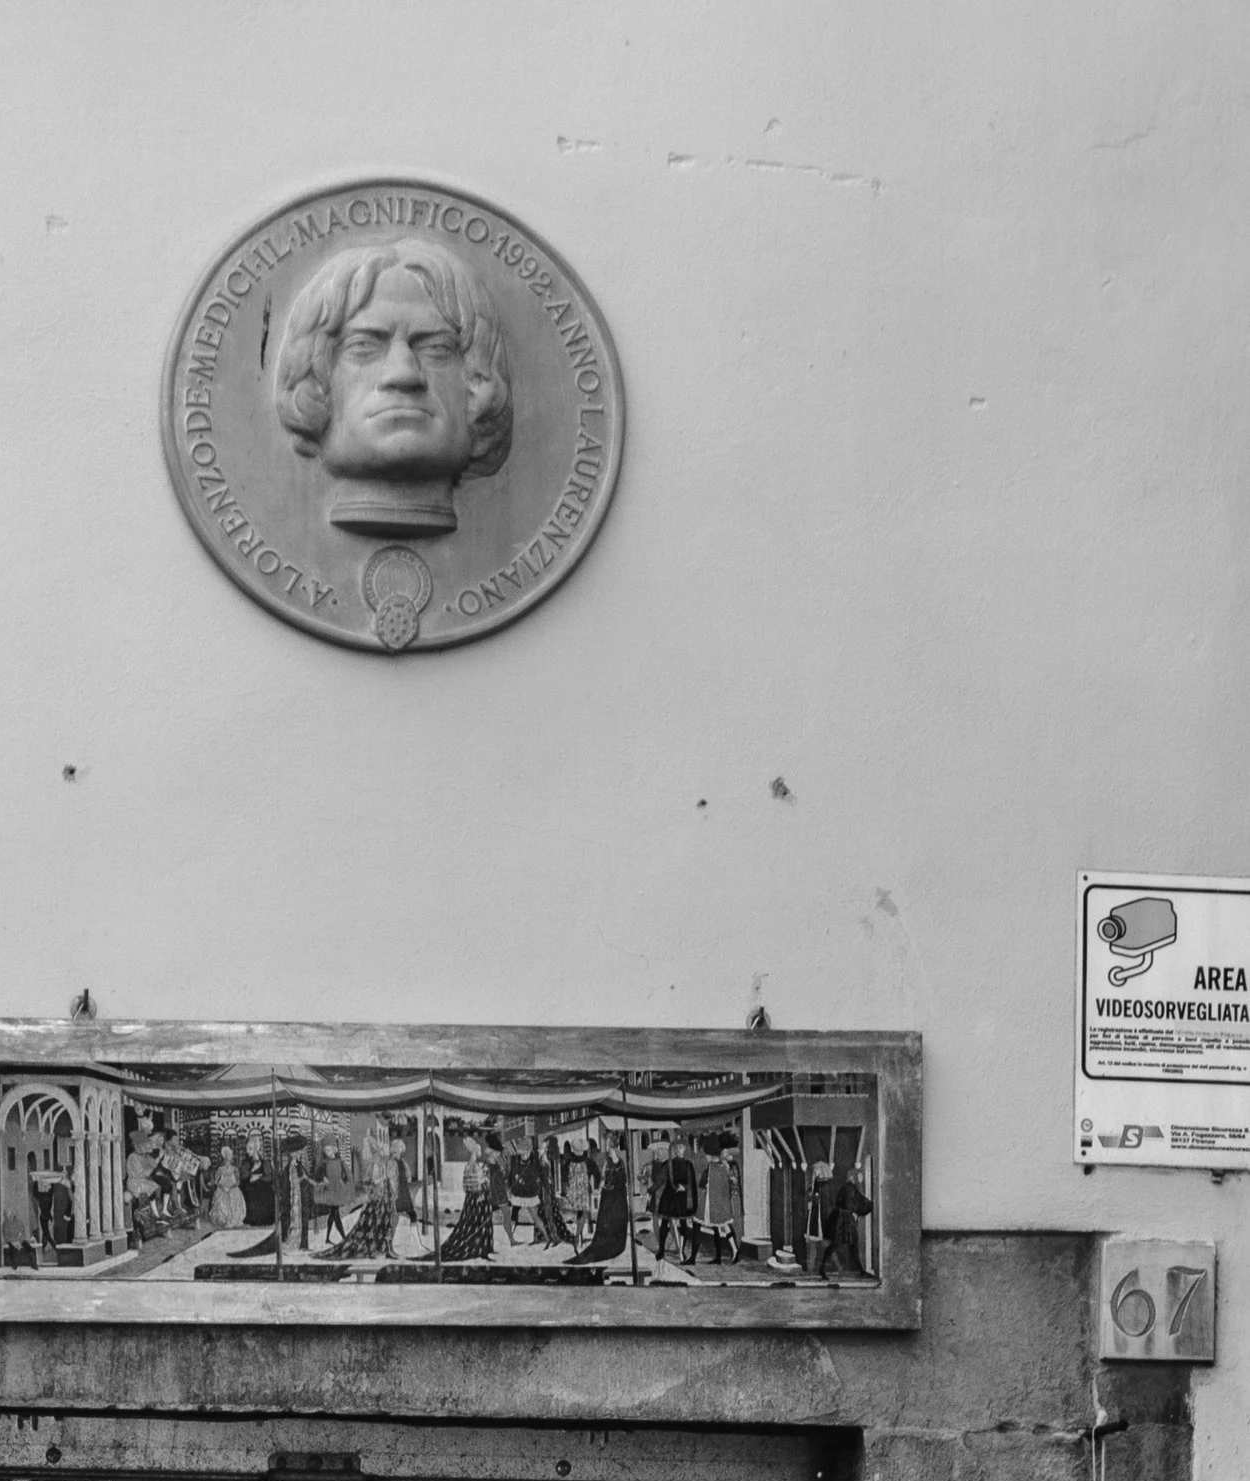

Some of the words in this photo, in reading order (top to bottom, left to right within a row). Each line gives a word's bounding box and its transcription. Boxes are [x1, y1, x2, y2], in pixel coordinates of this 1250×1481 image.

[295, 196, 490, 248] MAGNIFICO
[258, 236, 292, 274] IL
[492, 234, 553, 296] 1992
[187, 263, 260, 382] MEDICI
[545, 299, 605, 396] ANNO
[185, 388, 215, 434] DE
[189, 441, 306, 596] LORENZO
[457, 404, 607, 618] LAURENZIANO
[1193, 966, 1248, 992] AREA
[1095, 998, 1250, 1023] VIDEOSORVEGLIATA
[1110, 1266, 1207, 1337] 67
